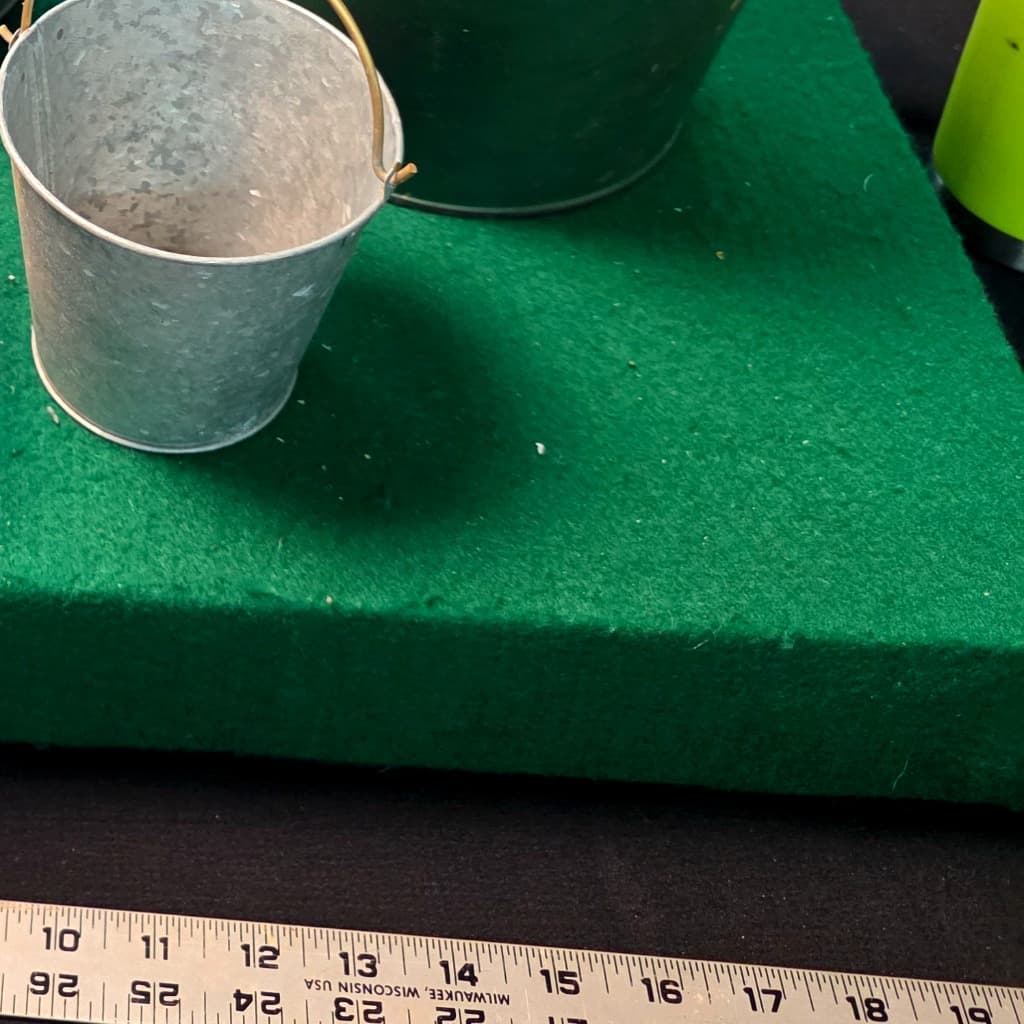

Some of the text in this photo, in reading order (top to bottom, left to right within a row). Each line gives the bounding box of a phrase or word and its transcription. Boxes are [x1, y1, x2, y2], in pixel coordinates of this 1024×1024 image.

[30, 971, 79, 998] 26
[42, 926, 81, 952] 10
[141, 934, 169, 960] 11
[240, 943, 280, 969] 12
[339, 951, 378, 978] 13
[439, 960, 479, 987] 14
[539, 969, 581, 995] 15
[641, 977, 683, 1004] 16
[743, 986, 783, 1013] 17
[846, 996, 888, 1022] 18
[950, 1005, 992, 1024] 19
[131, 980, 180, 1007] 25
[232, 988, 282, 1016] 24
[303, 978, 510, 1006] MILWAUKEE, WISCONSIN USA
[334, 996, 384, 1024] 23
